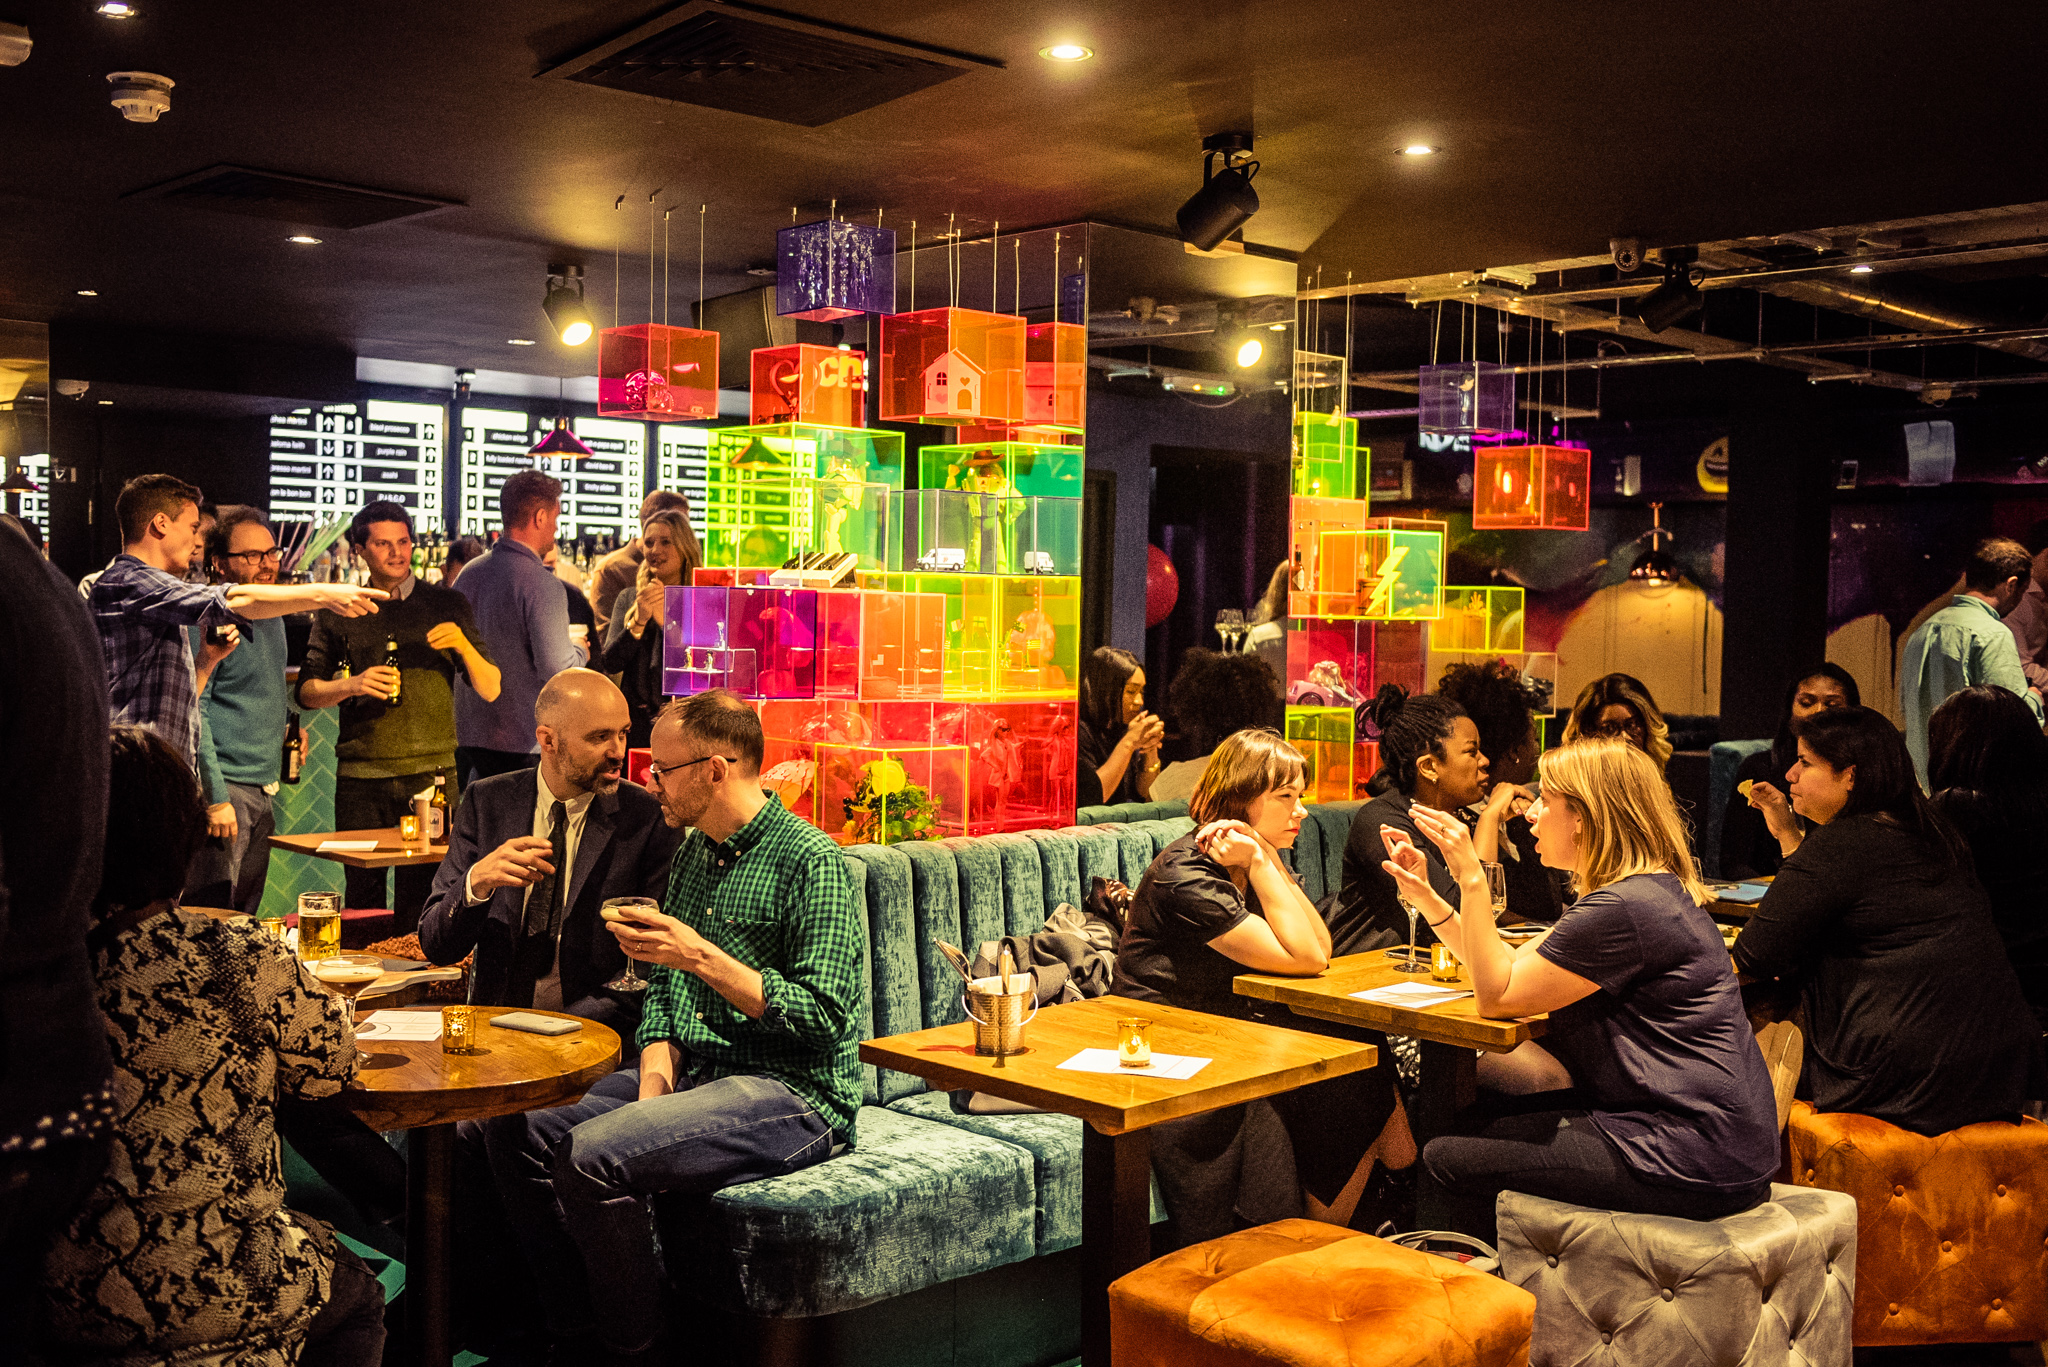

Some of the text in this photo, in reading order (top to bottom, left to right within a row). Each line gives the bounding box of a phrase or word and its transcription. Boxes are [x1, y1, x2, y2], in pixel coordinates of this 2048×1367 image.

[819, 344, 869, 392] ch
[346, 444, 353, 454] 7
[563, 459, 570, 469] 7
